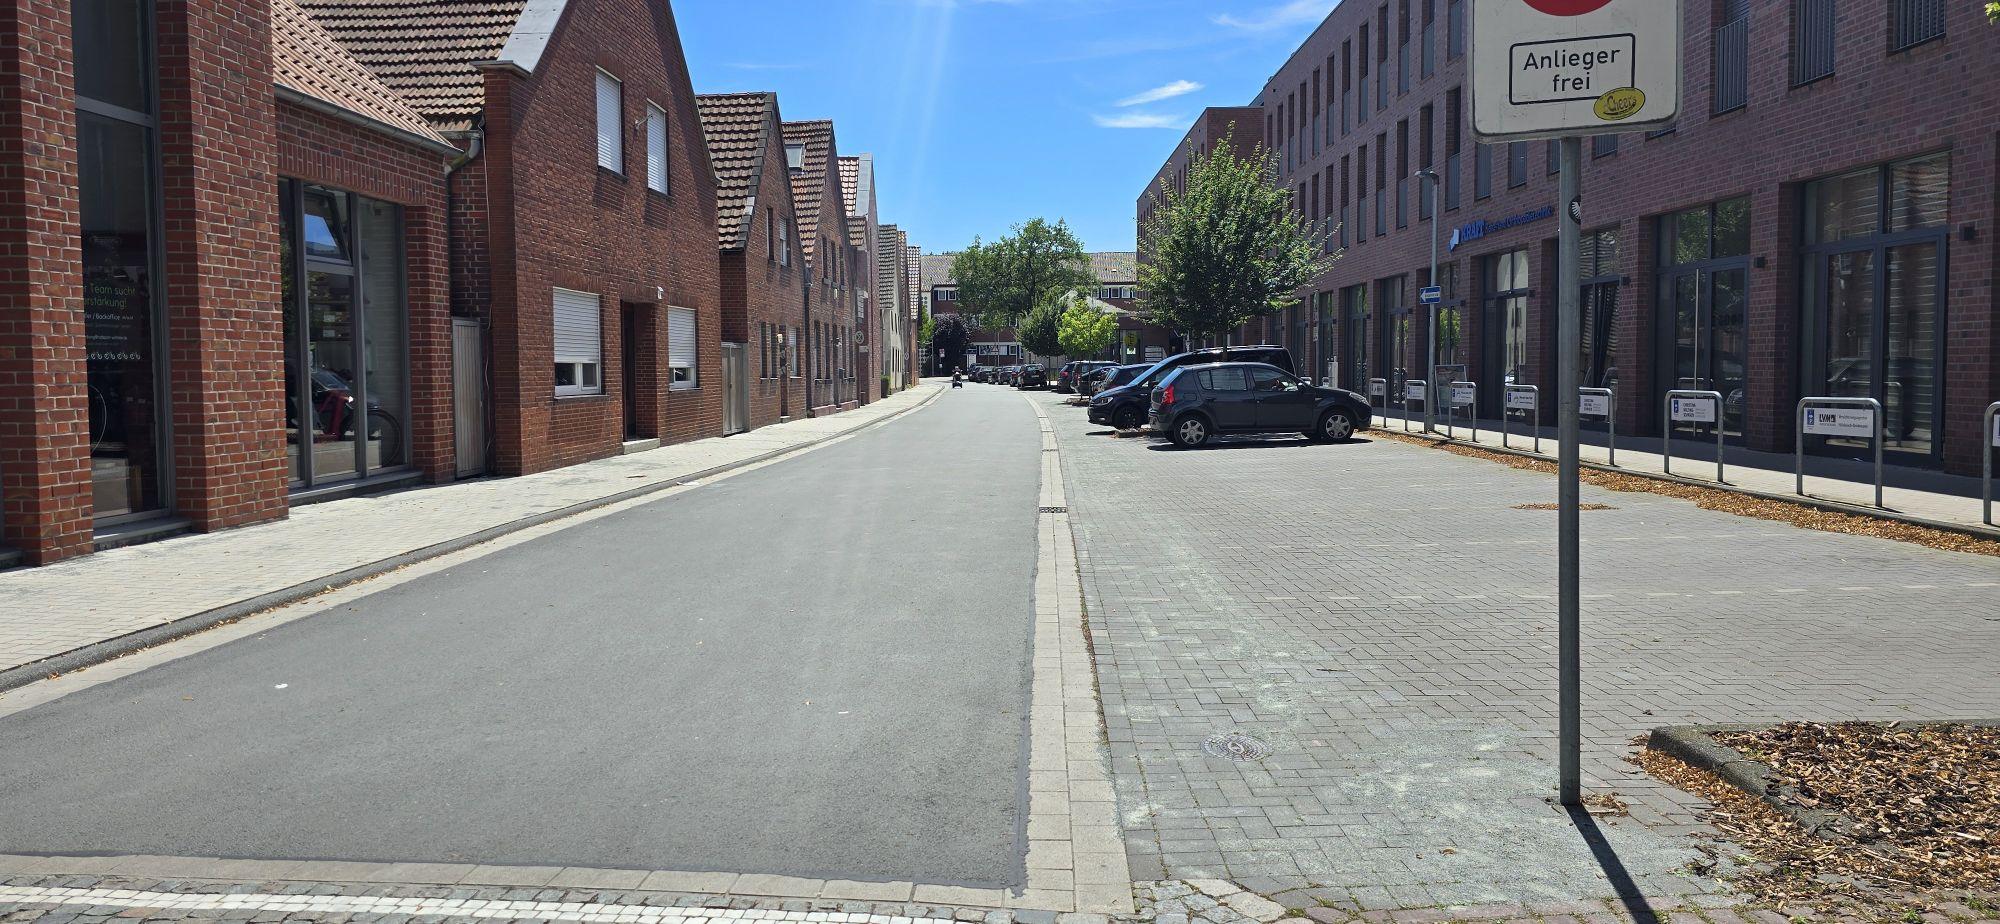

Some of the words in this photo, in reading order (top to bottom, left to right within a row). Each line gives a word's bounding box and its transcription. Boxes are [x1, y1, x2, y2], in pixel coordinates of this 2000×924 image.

[1523, 49, 1620, 70] Anlieger
[1553, 72, 1590, 92] frei
[1461, 220, 1485, 241] KRAFT
[91, 283, 112, 294] Team
[114, 287, 135, 296] sucht
